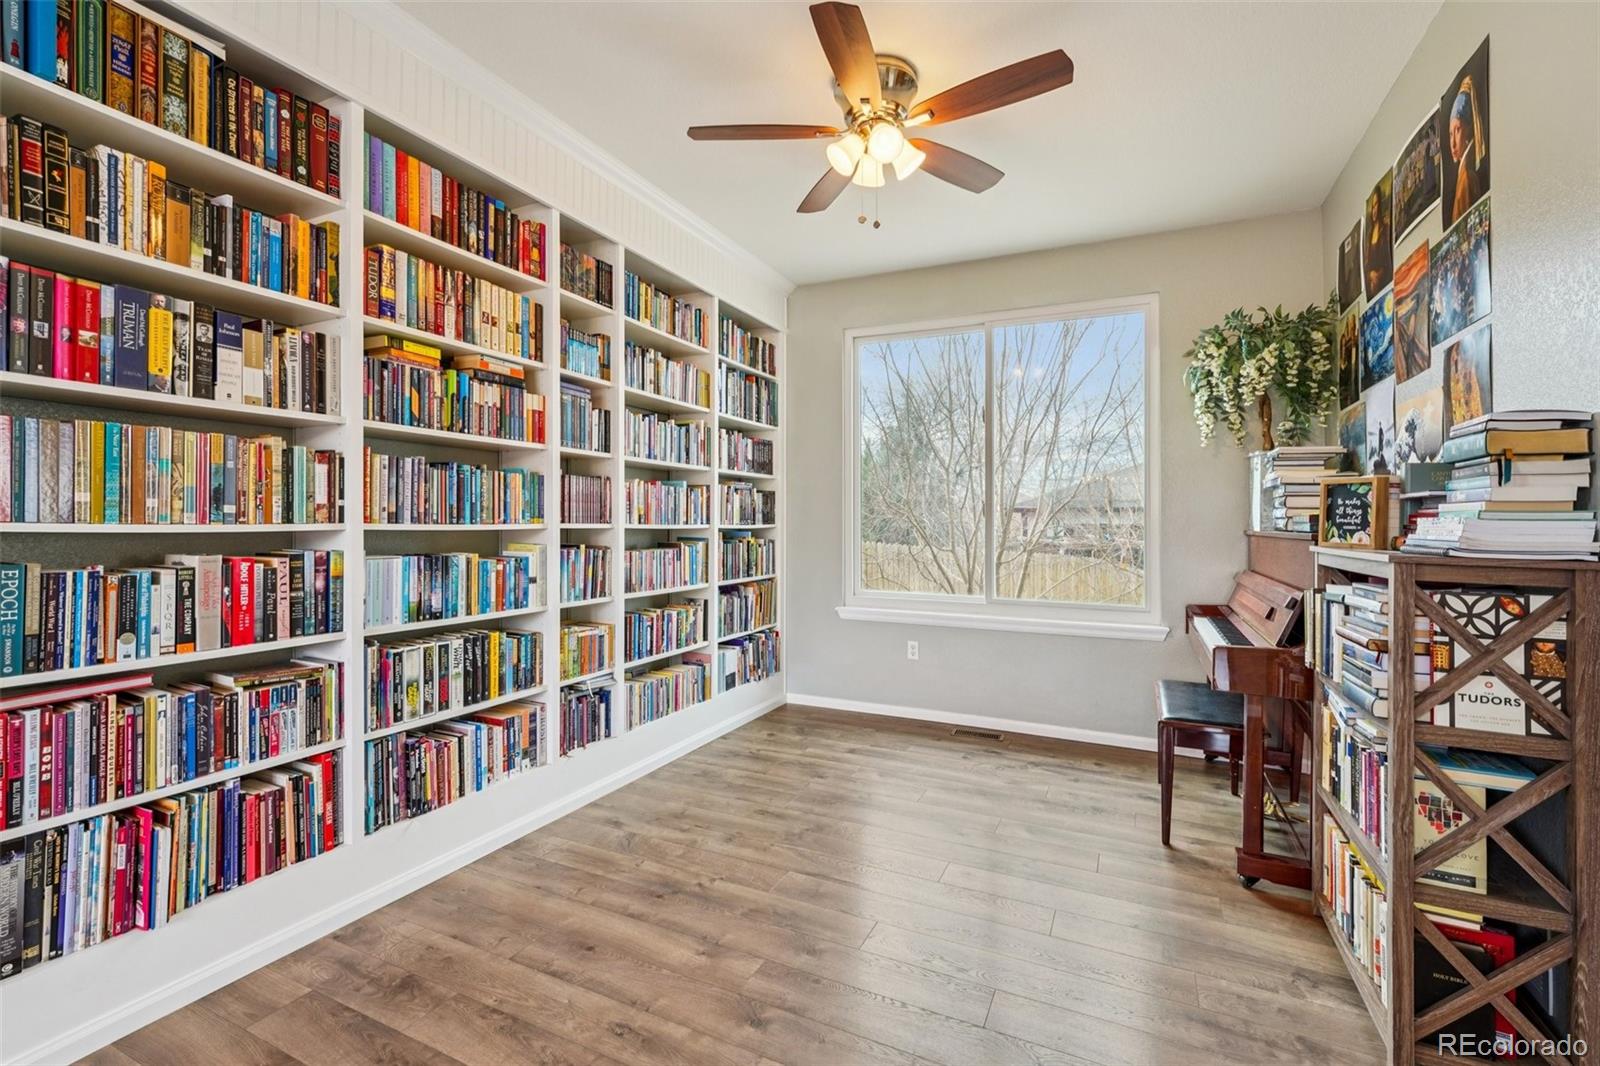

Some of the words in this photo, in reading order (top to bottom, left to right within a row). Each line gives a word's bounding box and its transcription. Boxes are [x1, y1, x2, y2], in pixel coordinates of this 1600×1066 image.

[228, 78, 237, 88] The
[228, 89, 237, 113] Princes
[228, 122, 237, 131] the
[228, 132, 237, 154] Tower
[368, 260, 378, 298] TUDOR
[122, 302, 135, 350] TRUMAN
[224, 322, 236, 331] Paul
[1336, 516, 1362, 524] beautiful
[240, 562, 250, 582] ADOLF
[1, 569, 18, 621] EPOCH
[184, 598, 192, 608] THE
[240, 584, 250, 605] HITLER
[266, 592, 276, 614] Paul
[184, 610, 192, 635] COMPANY
[4, 638, 12, 664] SWANSON
[1458, 693, 1521, 707] TUDORS
[197, 704, 207, 723] John
[12, 781, 20, 792] BILL
[12, 794, 20, 816] O'REILLY
[33, 840, 43, 855] Civil
[0, 868, 9, 906] MODERN
[32, 870, 41, 889] Times
[0, 907, 8, 937] WORLD
[1450, 976, 1468, 984] BIBLE
